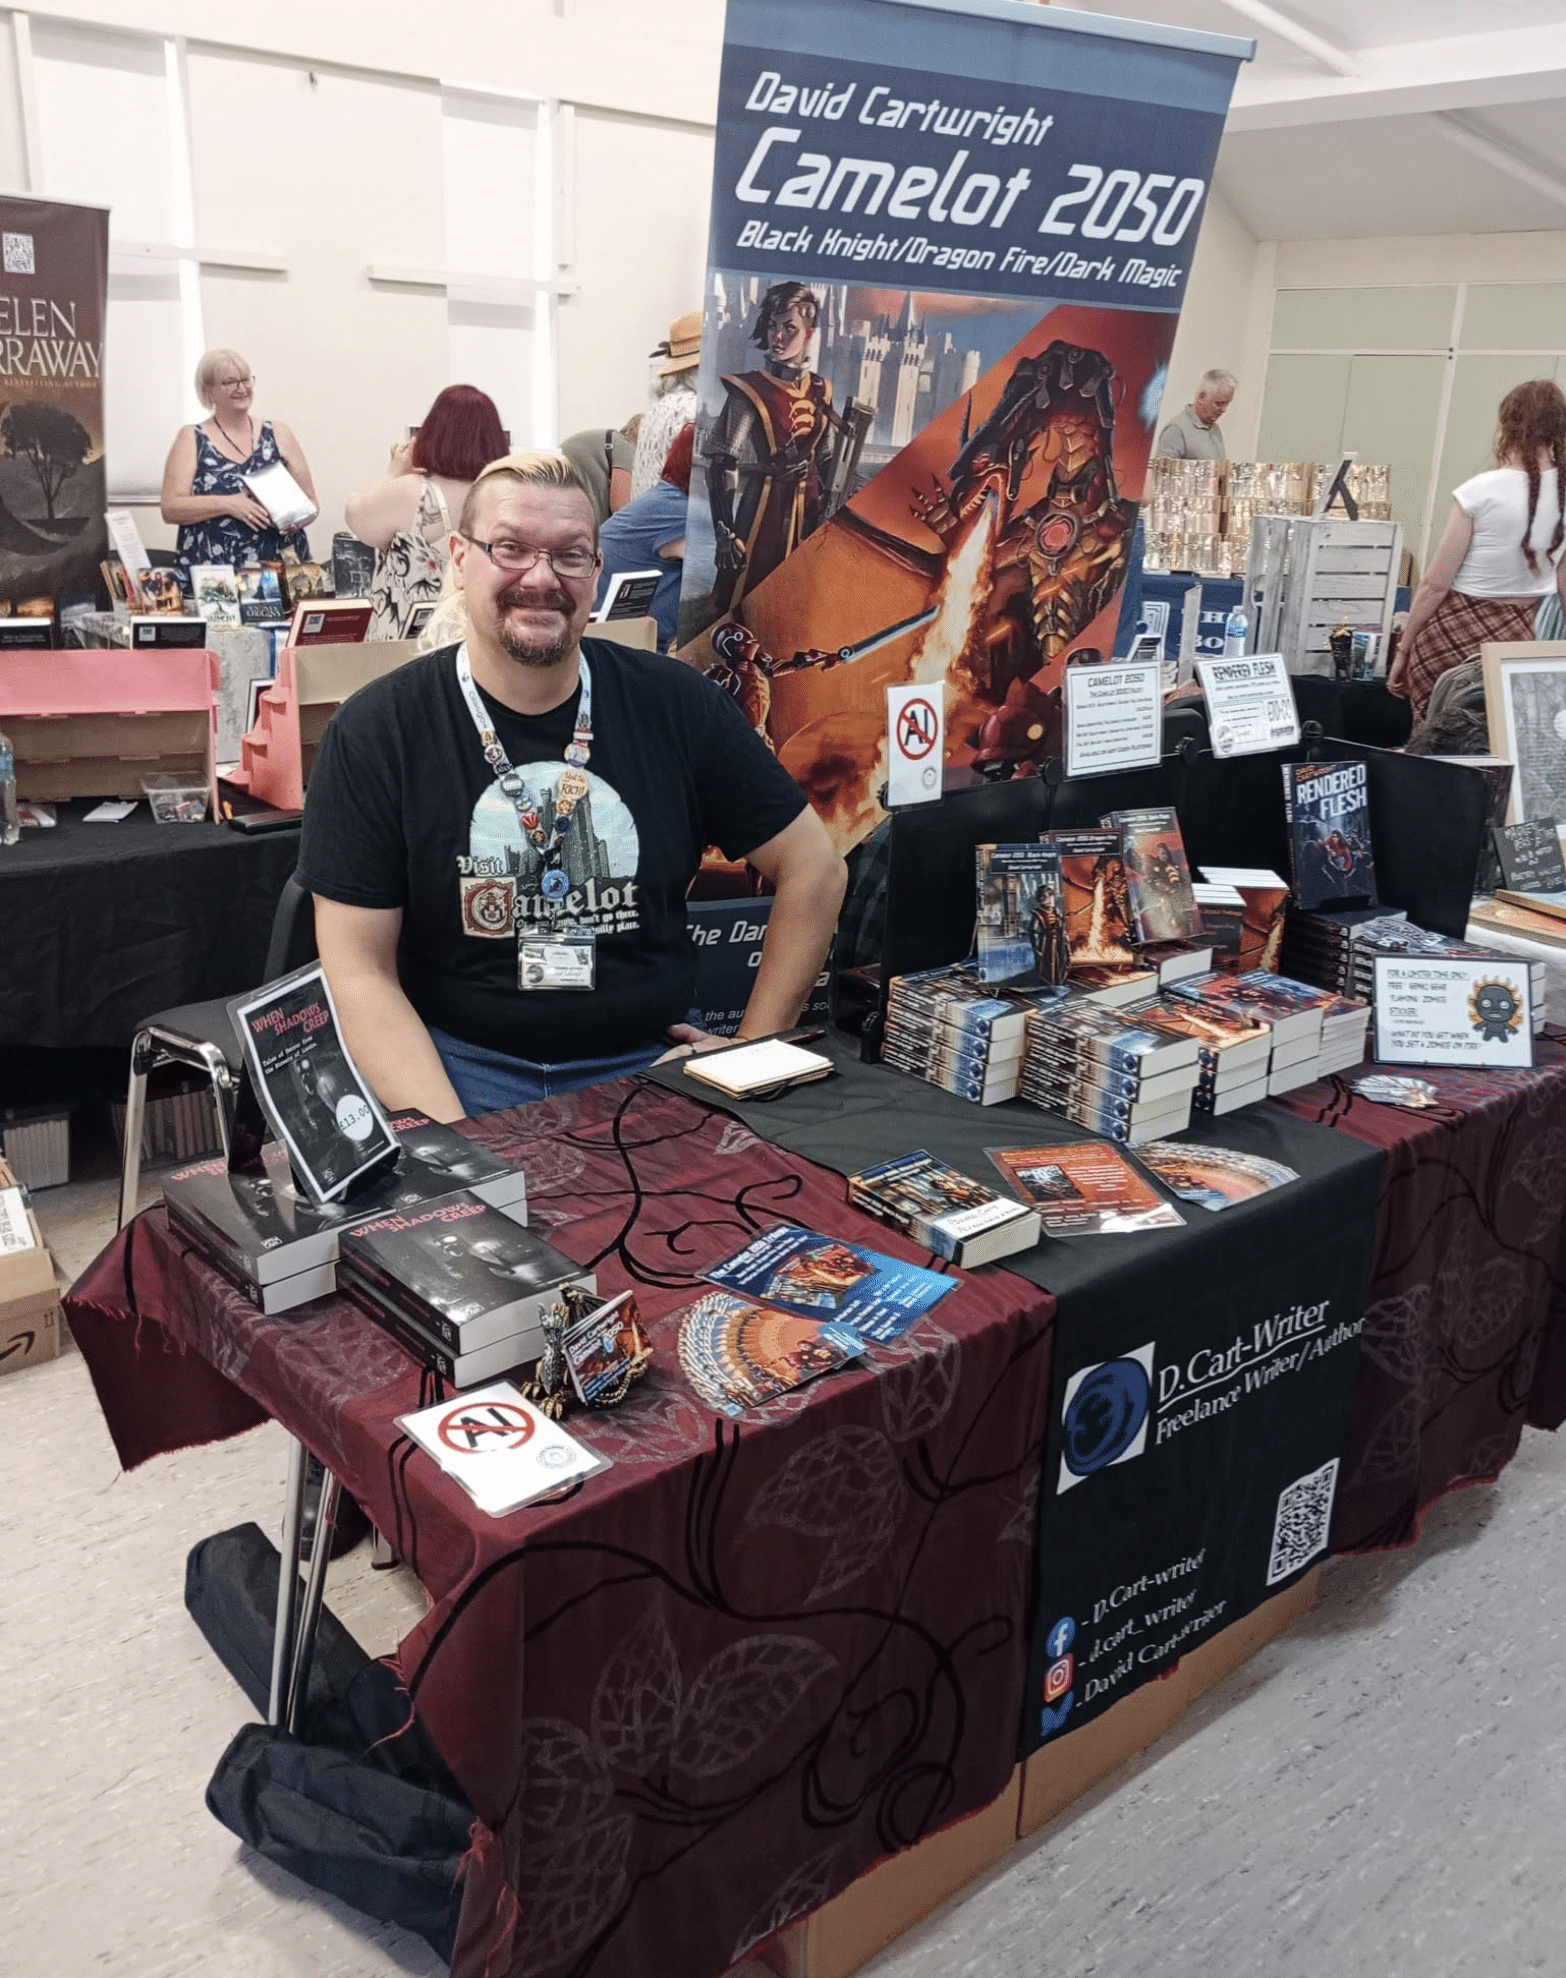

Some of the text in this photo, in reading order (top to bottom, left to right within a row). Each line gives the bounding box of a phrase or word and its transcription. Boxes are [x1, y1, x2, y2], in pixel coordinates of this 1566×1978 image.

[745, 71, 1054, 146] David Cartwright
[735, 127, 1205, 247] Camelot 2050
[736, 220, 1184, 288] Black Knight/Dragon Fire/Dark Magic
[1296, 764, 1367, 804] RENDERED
[1320, 786, 1367, 821] FLESH
[456, 855, 505, 876] Visit
[251, 1007, 285, 1034] WHEN
[274, 1002, 321, 1036] SHADOWS
[302, 1009, 329, 1033] CREEP
[705, 1010, 725, 1022] the
[338, 1103, 371, 1132] £13.00
[349, 1214, 407, 1237] WHEN
[388, 1202, 470, 1233] SHADOWS
[440, 1204, 487, 1223] CREEP
[1244, 1317, 1366, 1395] Writer/Author
[1155, 1385, 1241, 1445] Freelance
[1084, 1651, 1133, 1702] David
